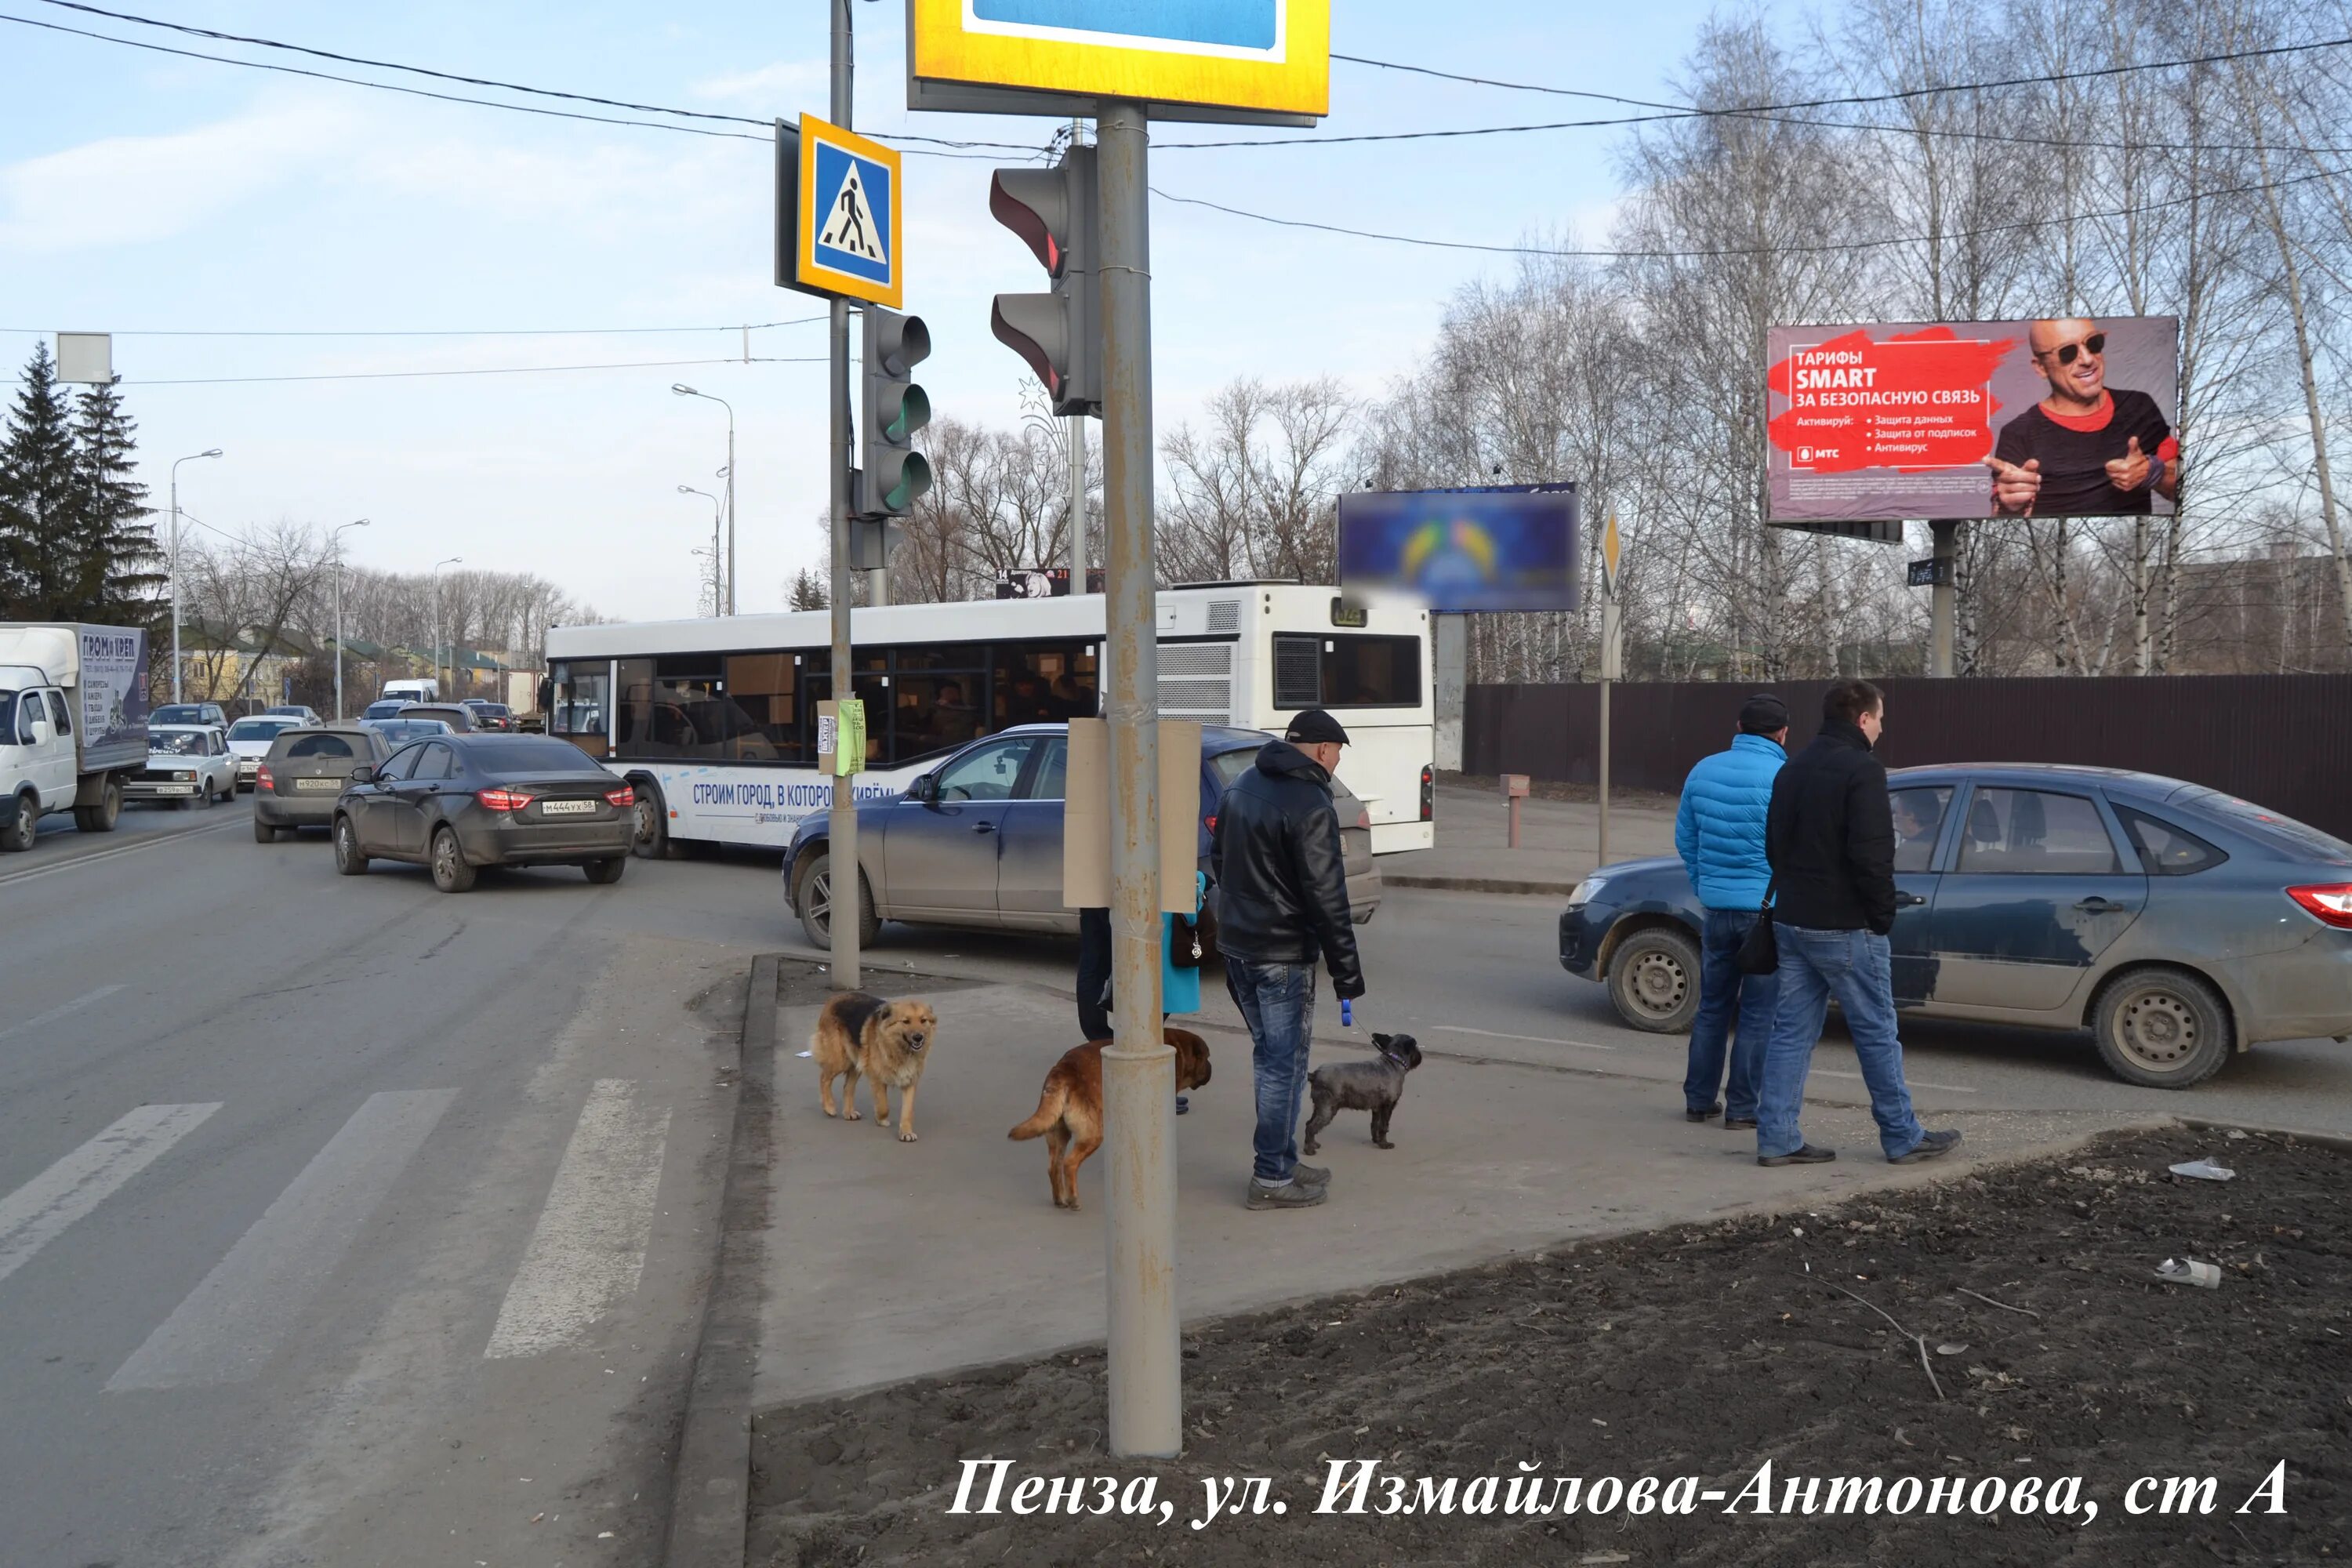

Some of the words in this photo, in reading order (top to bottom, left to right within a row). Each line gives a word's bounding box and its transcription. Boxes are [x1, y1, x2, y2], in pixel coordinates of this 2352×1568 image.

[1796, 350, 1862, 366] ТАРИФЫ
[1796, 368, 1877, 389] SMART
[1796, 393, 1816, 407] ЗА
[1820, 390, 1928, 406] БЕЗОПАСНУЮ
[1932, 390, 1980, 404] СВЯЗЬ
[1797, 415, 1854, 428] Активируй:
[1874, 415, 1911, 426] Защита
[1913, 415, 1953, 425] данных
[1874, 428, 1911, 439] Защита
[1928, 428, 1976, 438] подписок
[1874, 442, 1928, 454] Антивирус
[997, 569, 1007, 579] 14
[1057, 569, 1067, 579] 21
[83, 636, 109, 658] ПРОМ
[114, 637, 134, 659] КРЕП
[693, 783, 735, 805] СТРОИМ
[737, 784, 775, 810] ГОРОД,
[778, 785, 784, 806] В
[788, 785, 834, 808] КОТОРО
